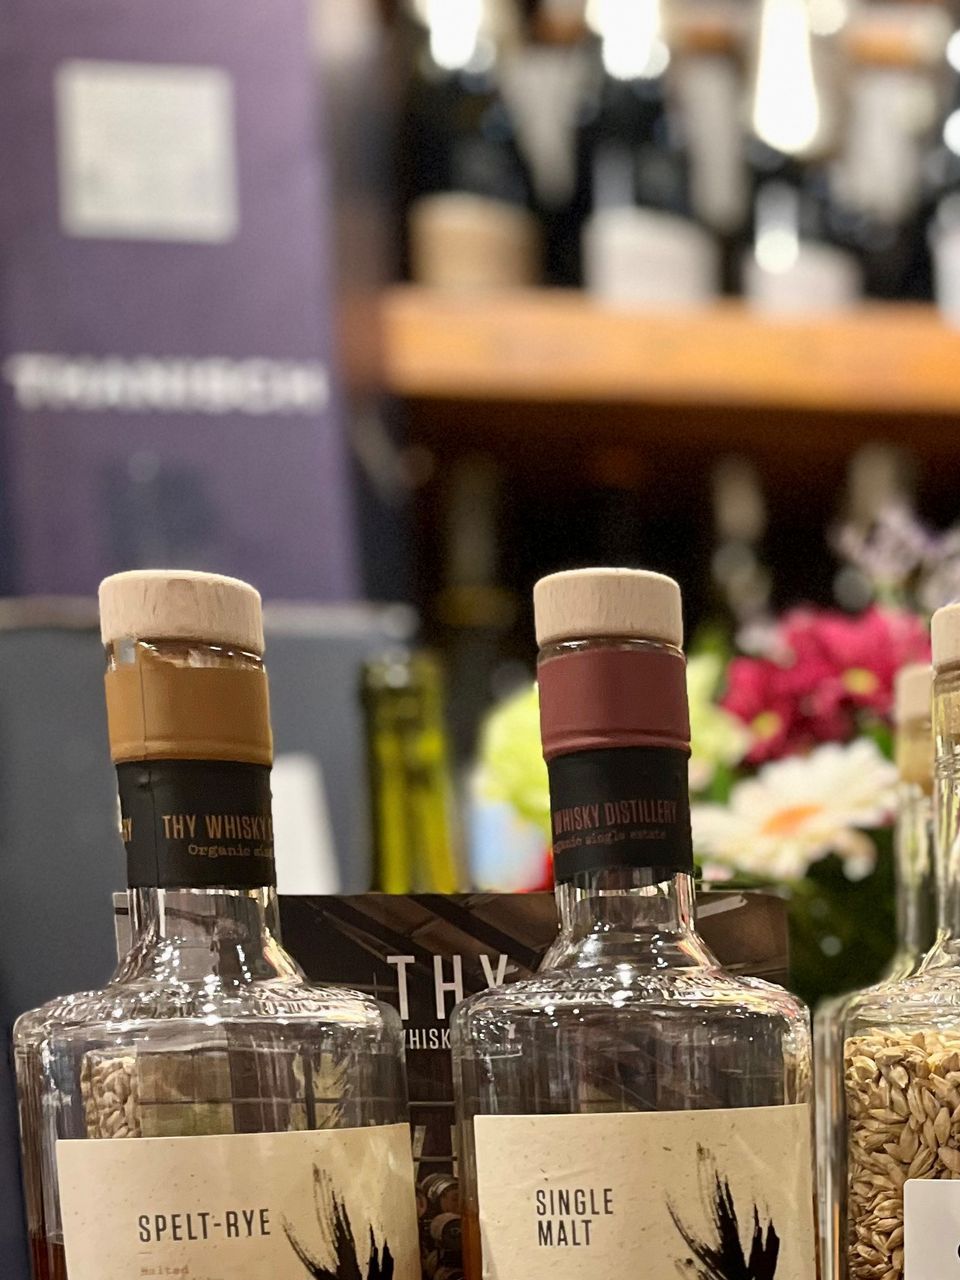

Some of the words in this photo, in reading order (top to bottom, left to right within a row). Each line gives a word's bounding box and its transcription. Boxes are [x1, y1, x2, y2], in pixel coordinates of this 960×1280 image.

[604, 800, 677, 826] DISTILLERY
[162, 815, 197, 840] THY
[205, 814, 266, 840] WHISKY
[188, 844, 250, 858] Organic
[400, 1028, 452, 1050] HISK
[536, 1188, 614, 1216] SINGLE
[138, 1208, 272, 1243] SPELT-RYE
[537, 1220, 593, 1247] MALT
